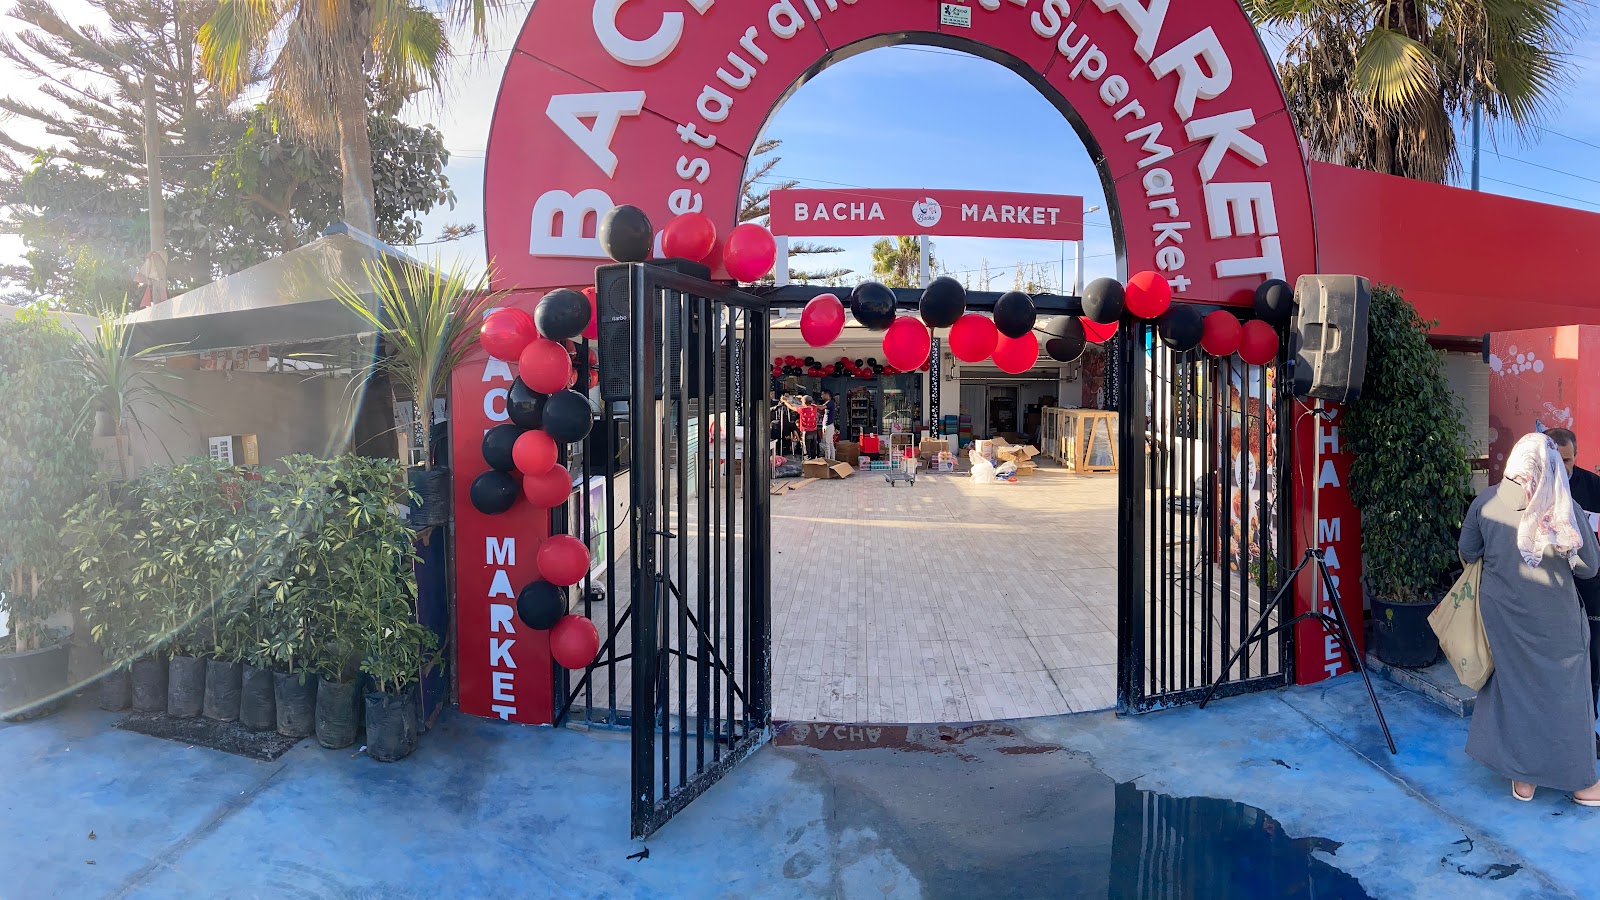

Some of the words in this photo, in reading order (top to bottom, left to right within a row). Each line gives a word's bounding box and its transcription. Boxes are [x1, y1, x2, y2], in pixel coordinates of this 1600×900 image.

[529, 0, 715, 259] BAC
[794, 202, 885, 222] BACHA
[961, 203, 1061, 225] MARKET
